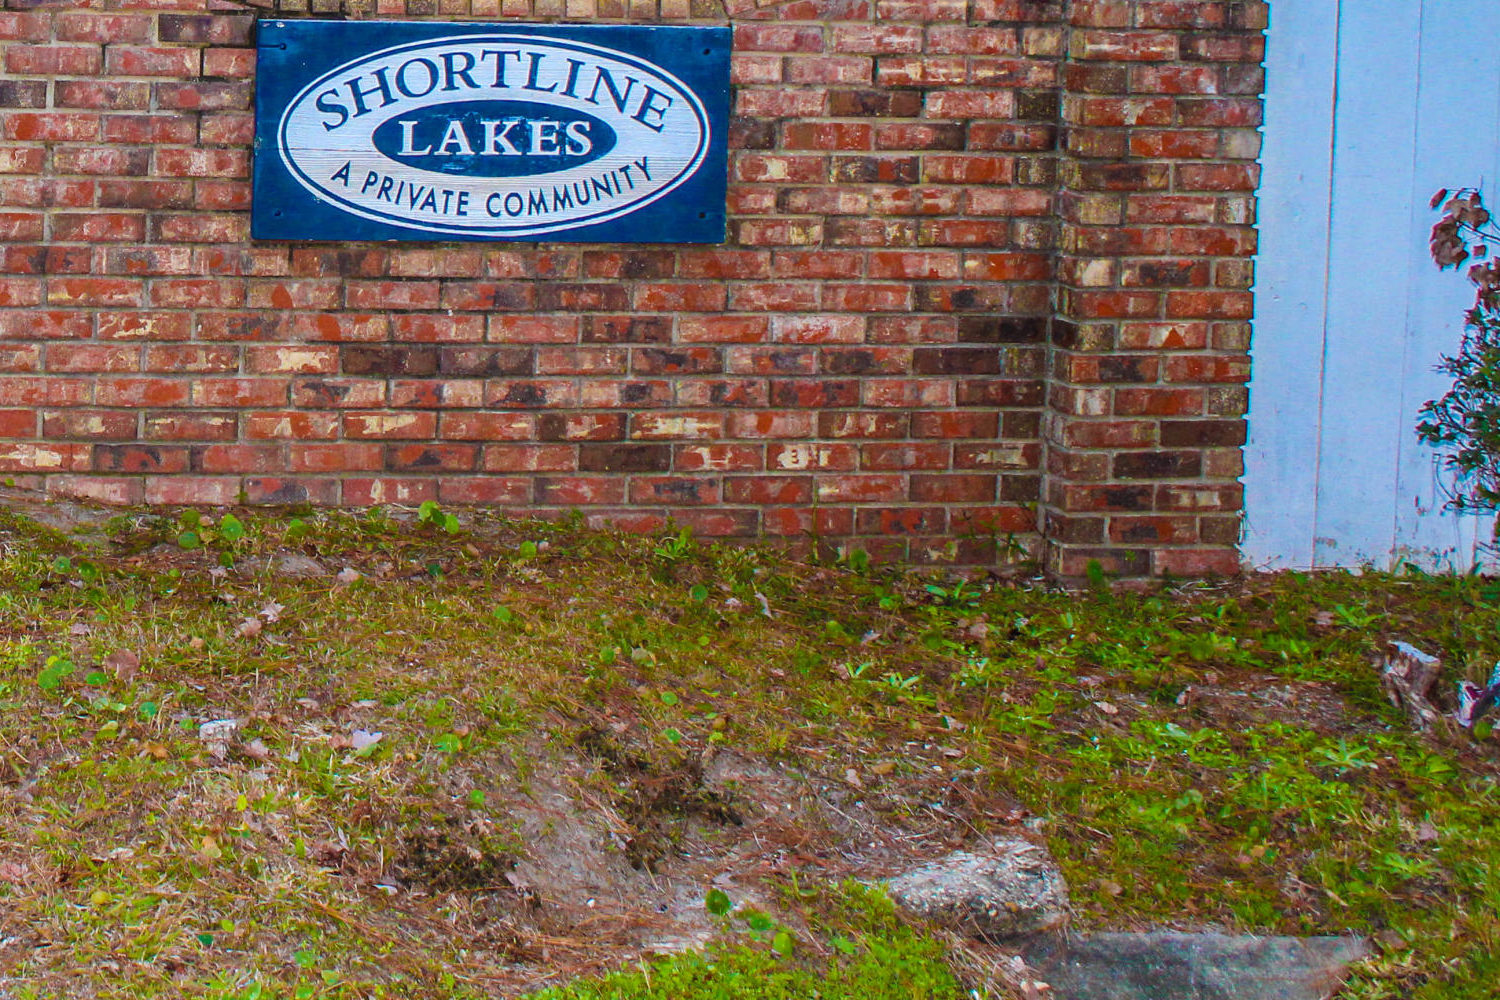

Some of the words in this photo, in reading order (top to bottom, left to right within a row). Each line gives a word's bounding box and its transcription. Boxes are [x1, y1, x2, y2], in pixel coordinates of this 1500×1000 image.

[315, 49, 674, 134] SHORTLINE
[396, 119, 594, 158] LAKES
[330, 159, 351, 188] A
[361, 170, 469, 217] PRIVATE
[486, 156, 654, 218] COMMUNITY
